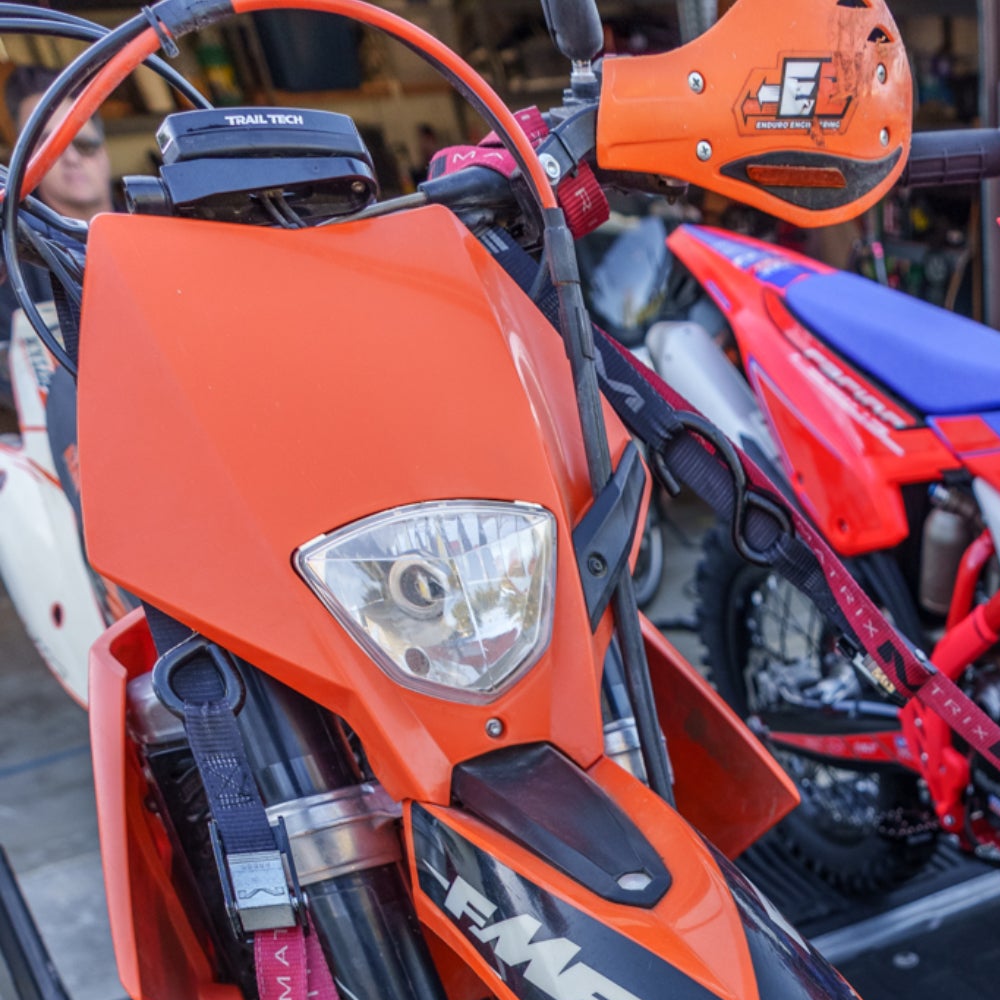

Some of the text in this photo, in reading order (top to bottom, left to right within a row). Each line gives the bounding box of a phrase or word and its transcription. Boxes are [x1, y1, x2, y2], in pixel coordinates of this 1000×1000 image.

[224, 113, 304, 126] TRAIL TECH
[755, 121, 789, 129] ENDURO
